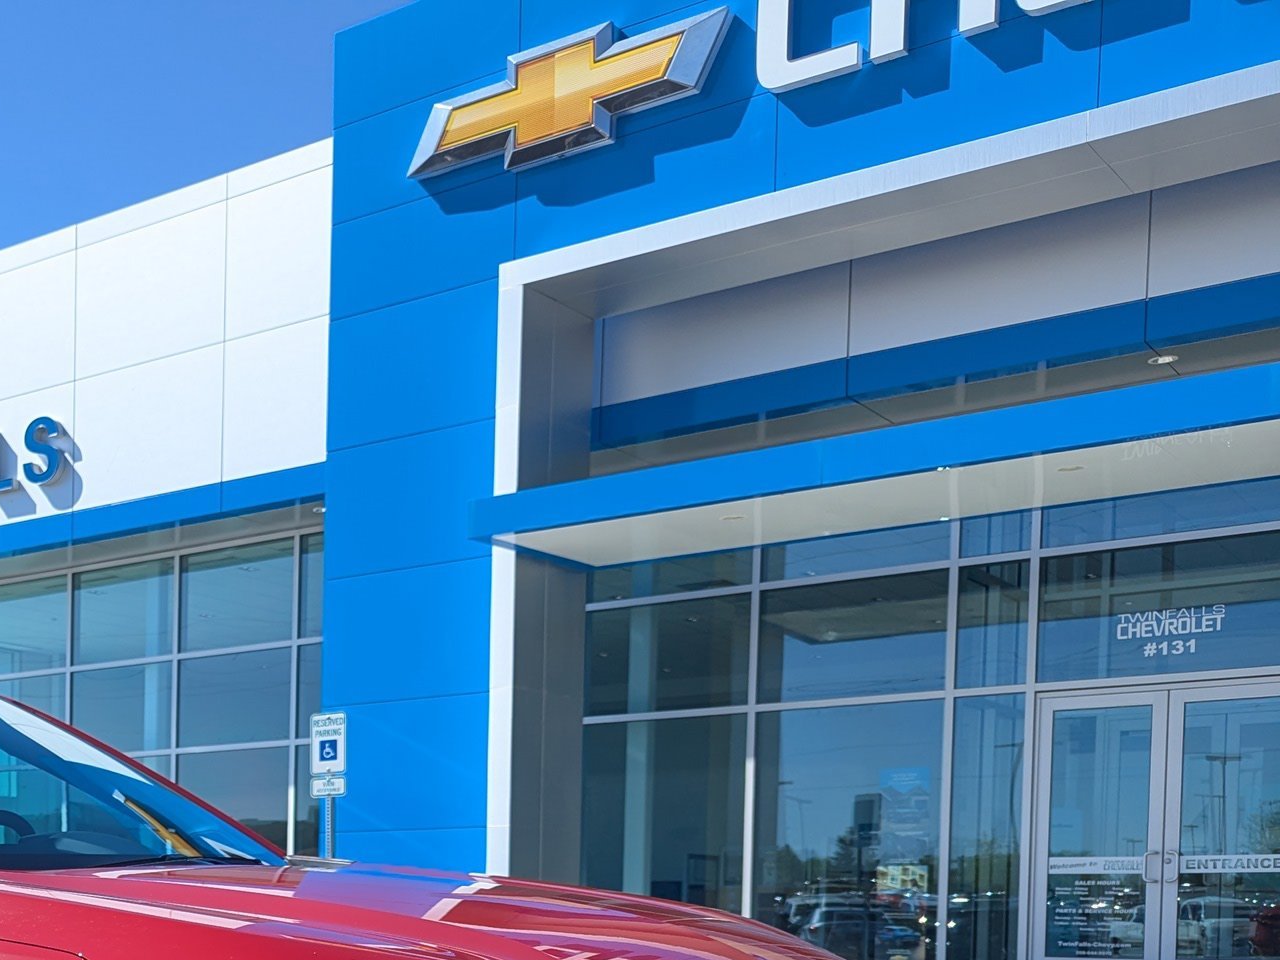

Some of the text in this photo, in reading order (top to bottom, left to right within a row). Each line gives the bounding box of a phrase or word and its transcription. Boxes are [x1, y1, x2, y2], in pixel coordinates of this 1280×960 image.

[1117, 614, 1225, 640] CHEVROLET
[1143, 639, 1196, 657] #131
[313, 717, 343, 728] RESERVED
[314, 728, 341, 738] PARKING
[1185, 858, 1280, 870] ENTRANCE
